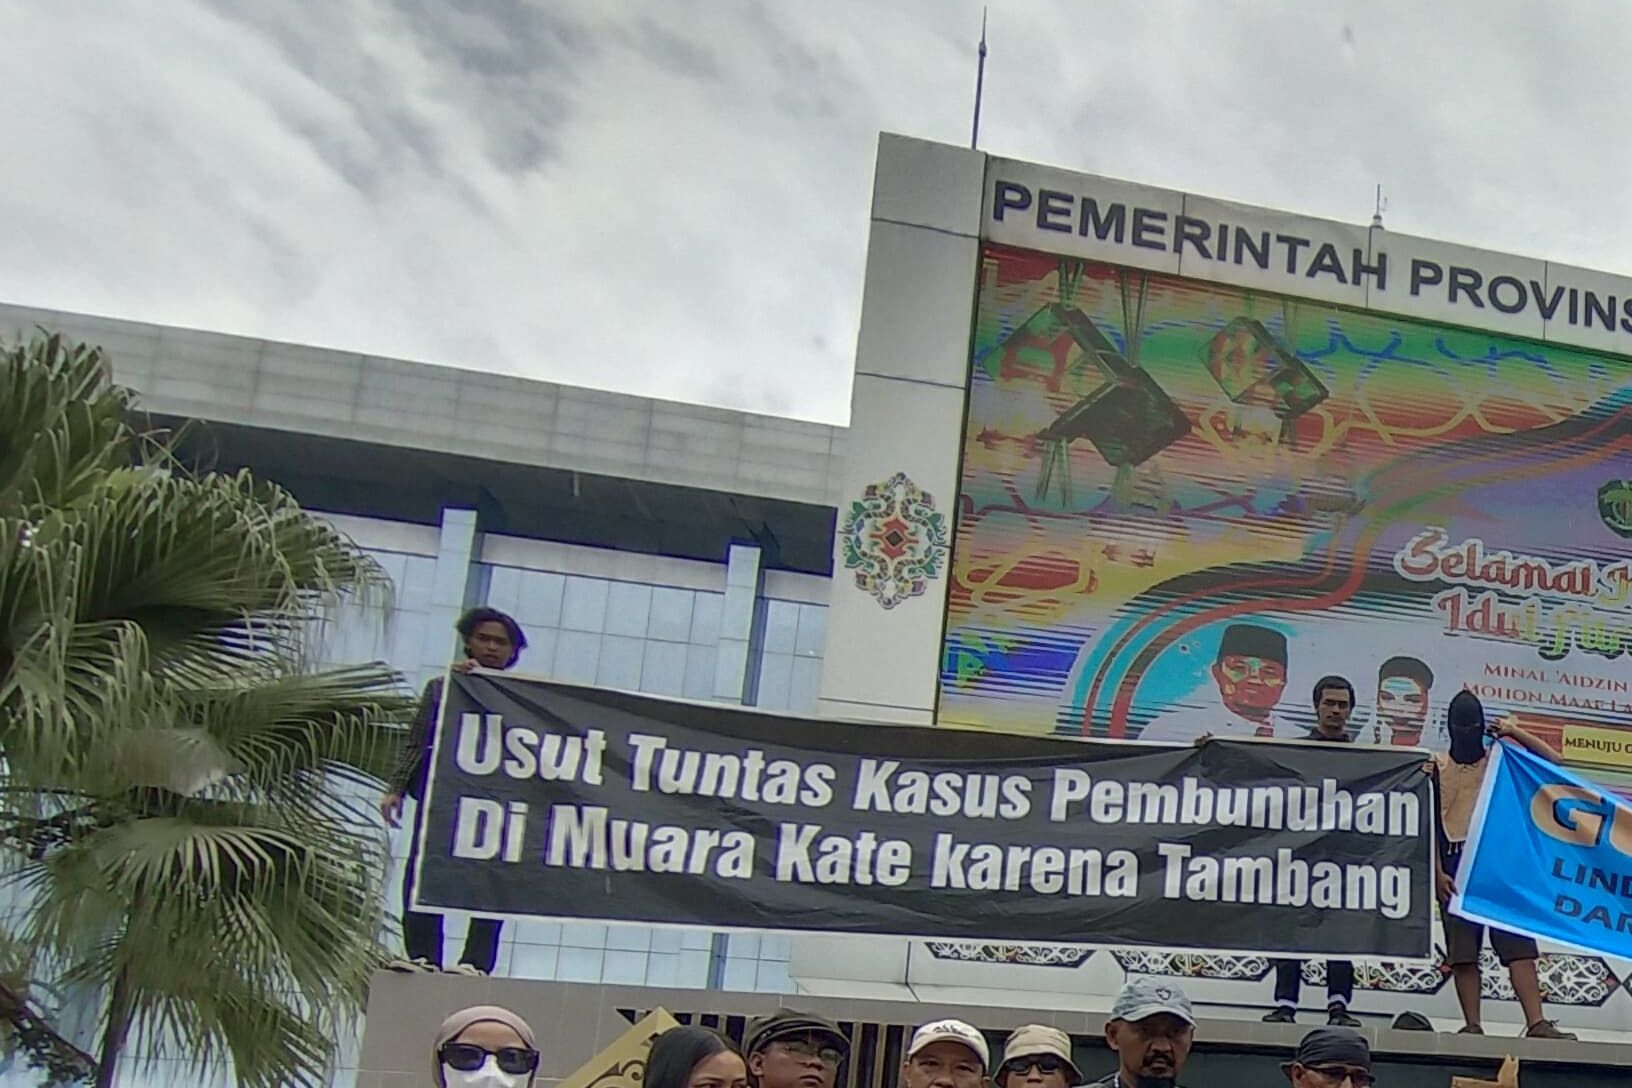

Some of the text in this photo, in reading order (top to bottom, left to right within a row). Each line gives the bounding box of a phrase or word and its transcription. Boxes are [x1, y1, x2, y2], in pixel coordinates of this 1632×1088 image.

[991, 179, 1388, 291] PEMERINTAH
[1400, 528, 1596, 597] Selamat
[1437, 590, 1541, 642] Idul
[456, 713, 1420, 838] Usut Tuntas Kasus Pembunuhan
[1564, 736, 1622, 753] MENUJU
[452, 795, 1412, 919] Di Muara Kate karena Tambang
